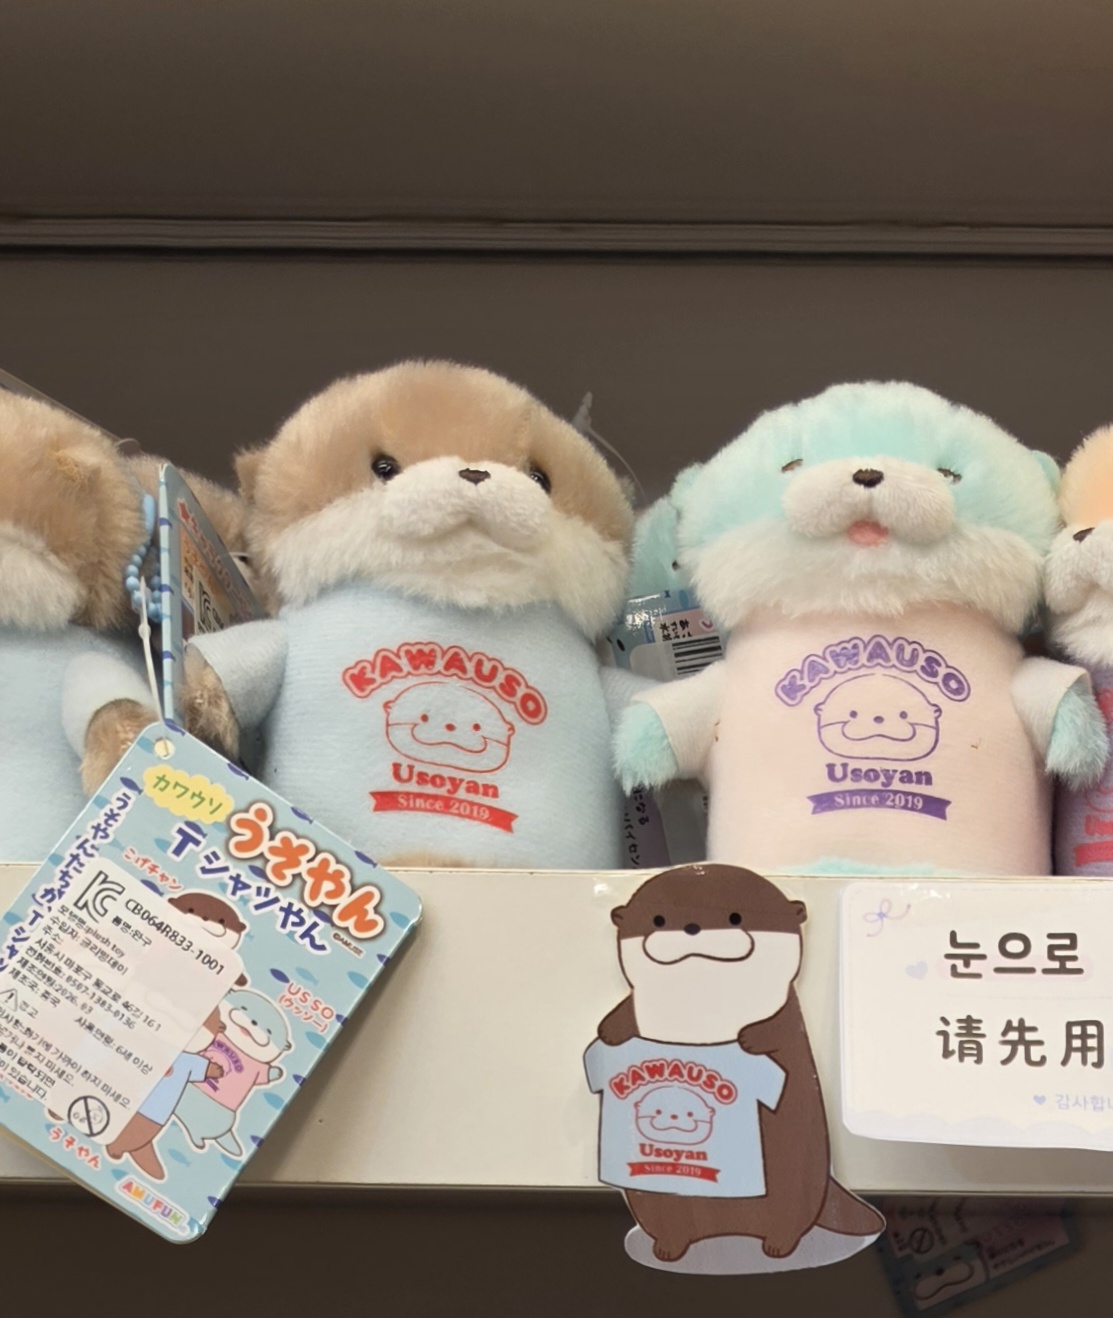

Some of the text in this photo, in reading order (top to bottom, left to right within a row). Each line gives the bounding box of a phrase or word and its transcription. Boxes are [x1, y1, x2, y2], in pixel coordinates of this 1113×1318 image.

[342, 641, 548, 726] KAWAUSO
[770, 634, 971, 707] KAWAUSO
[152, 774, 223, 815] カワウソ
[392, 762, 500, 799] Usoyan
[825, 762, 933, 788] Usoyan
[397, 794, 491, 821] Since 2019
[834, 792, 924, 810] Since 2019
[171, 827, 328, 953] Tシャツやん
[231, 806, 381, 934] うそやん
[110, 941, 126, 958] toy
[125, 899, 225, 976] CB064R833-1001
[944, 930, 1085, 980] 눈으로
[609, 1059, 738, 1105] KAWAUSO
[51, 1126, 100, 1170] うそやん
[639, 1143, 708, 1162] Usoyan
[644, 1165, 673, 1174] Since
[121, 1180, 183, 1226] AMUFUN
